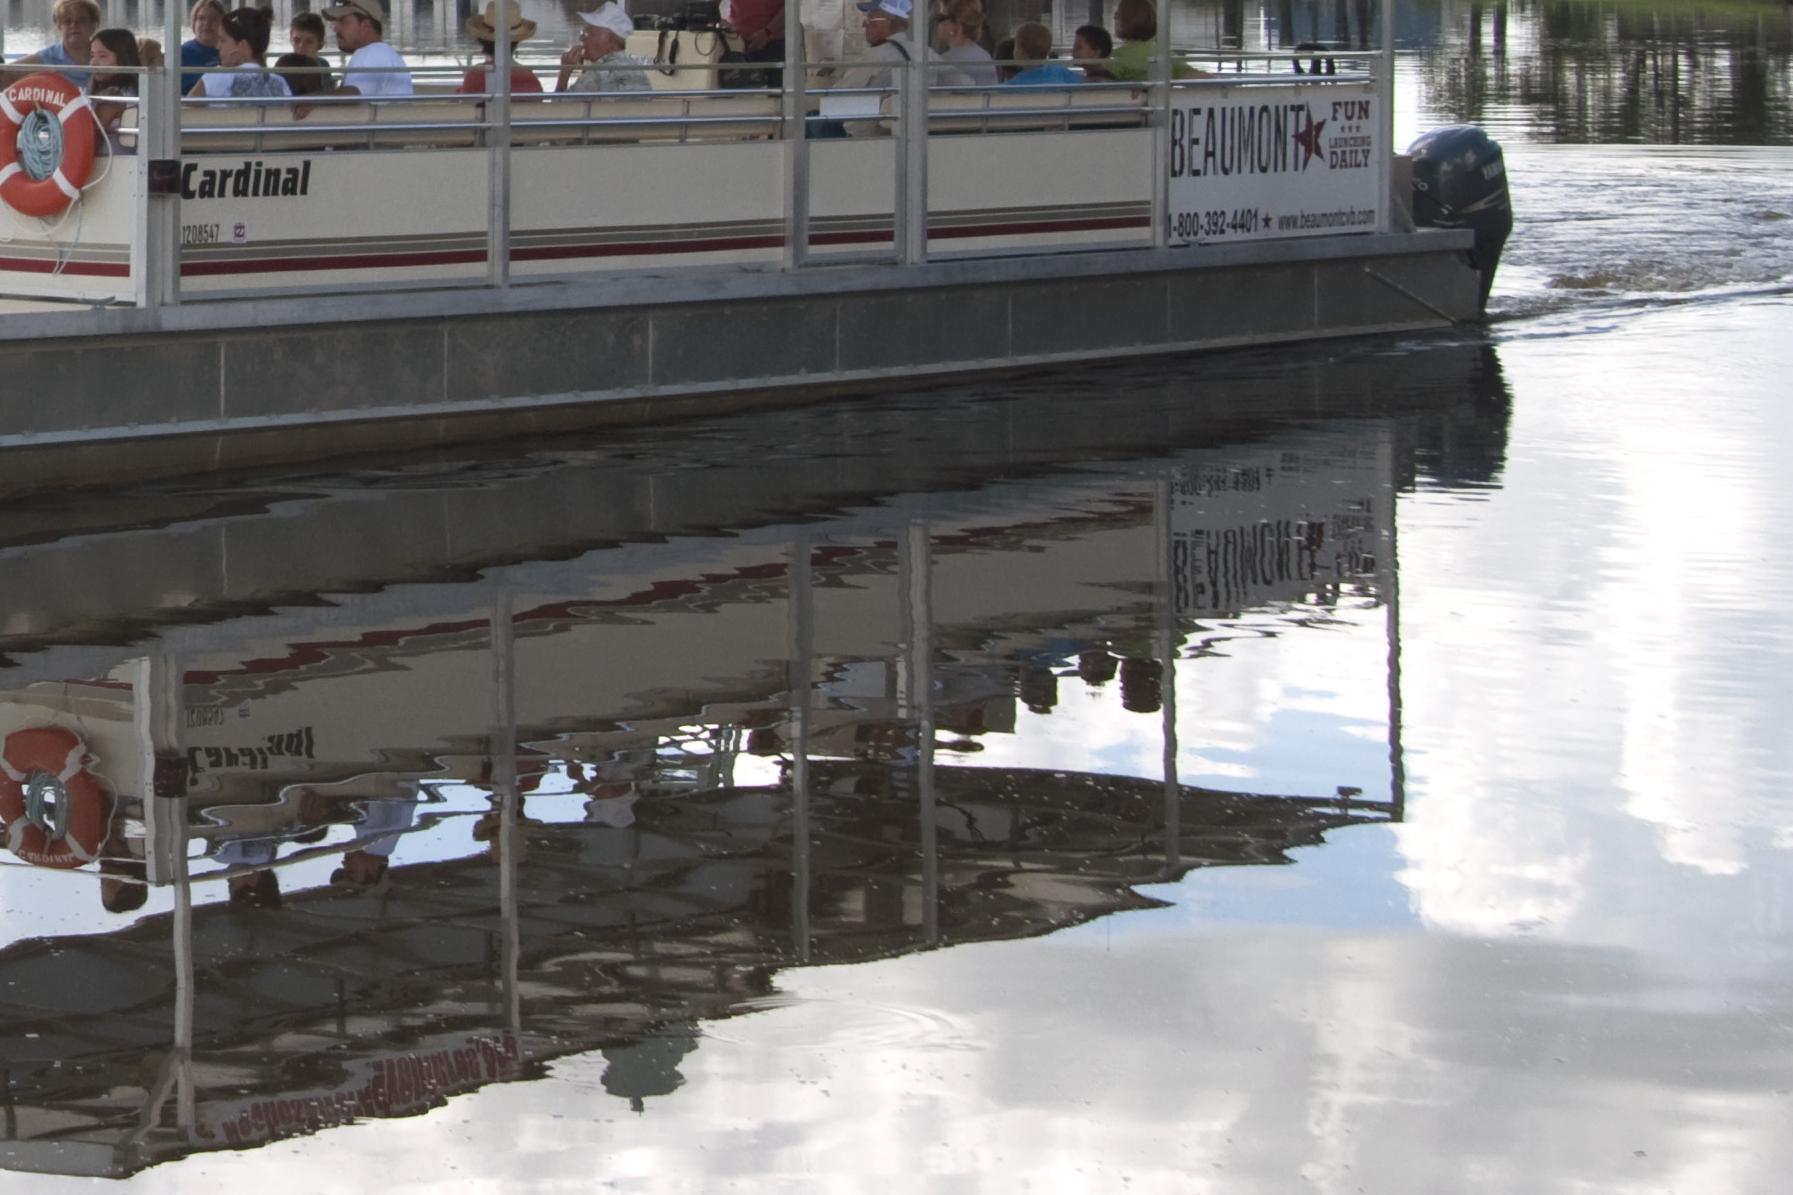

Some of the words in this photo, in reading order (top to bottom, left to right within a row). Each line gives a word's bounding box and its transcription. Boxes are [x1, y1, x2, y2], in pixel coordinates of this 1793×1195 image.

[8, 87, 66, 108] CARDINAL
[1331, 100, 1370, 122] FUN
[1170, 104, 1305, 178] BEAUMONT
[1328, 149, 1372, 170] DAILY
[181, 159, 311, 200] Cardinal
[1168, 207, 1259, 238] 1-800-392-4401
[182, 224, 220, 244] 1208547
